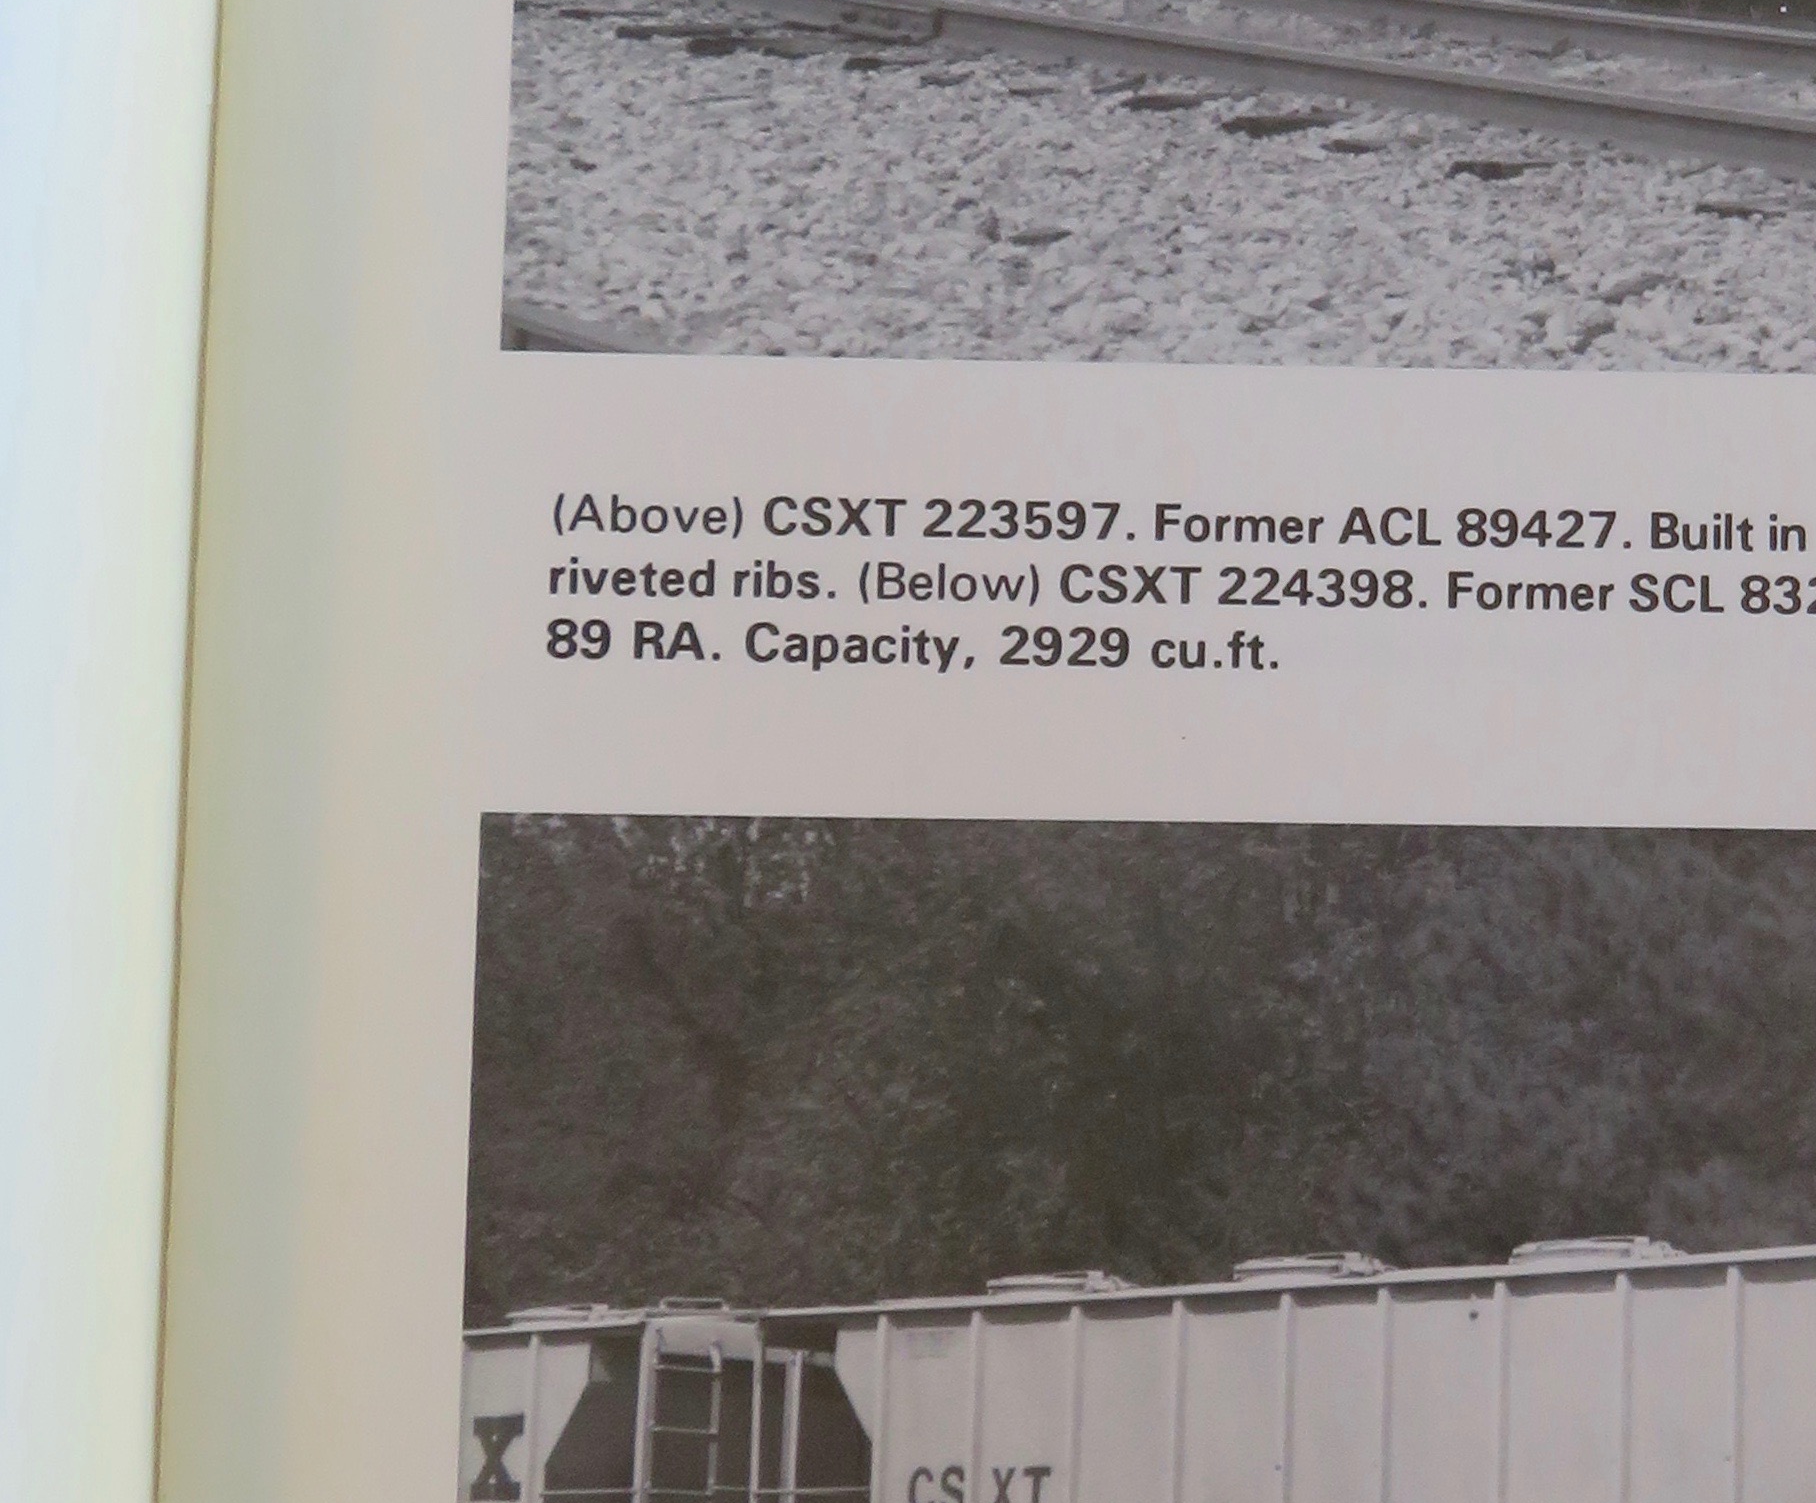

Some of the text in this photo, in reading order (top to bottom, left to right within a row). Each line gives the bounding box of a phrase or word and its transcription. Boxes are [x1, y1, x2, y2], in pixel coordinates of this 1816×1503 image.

[553, 492, 744, 539] (Above)
[763, 495, 908, 537] CSXT
[922, 498, 1136, 541] 223597.
[1154, 502, 1325, 545] Former
[1338, 506, 1442, 547] ACL
[1456, 507, 1632, 550] 89427.
[1650, 511, 1754, 553] Built
[1769, 513, 1807, 553] in
[549, 556, 716, 598] riveted
[733, 559, 836, 600] ribs.
[859, 561, 1040, 607] (Below)
[1059, 563, 1203, 605] CSXT
[1217, 566, 1428, 610] 224398.
[1447, 570, 1615, 612] Former
[1628, 572, 1725, 614] SCL
[546, 617, 1279, 674] 89 RA. Capacity, 2929 cu.ft.
